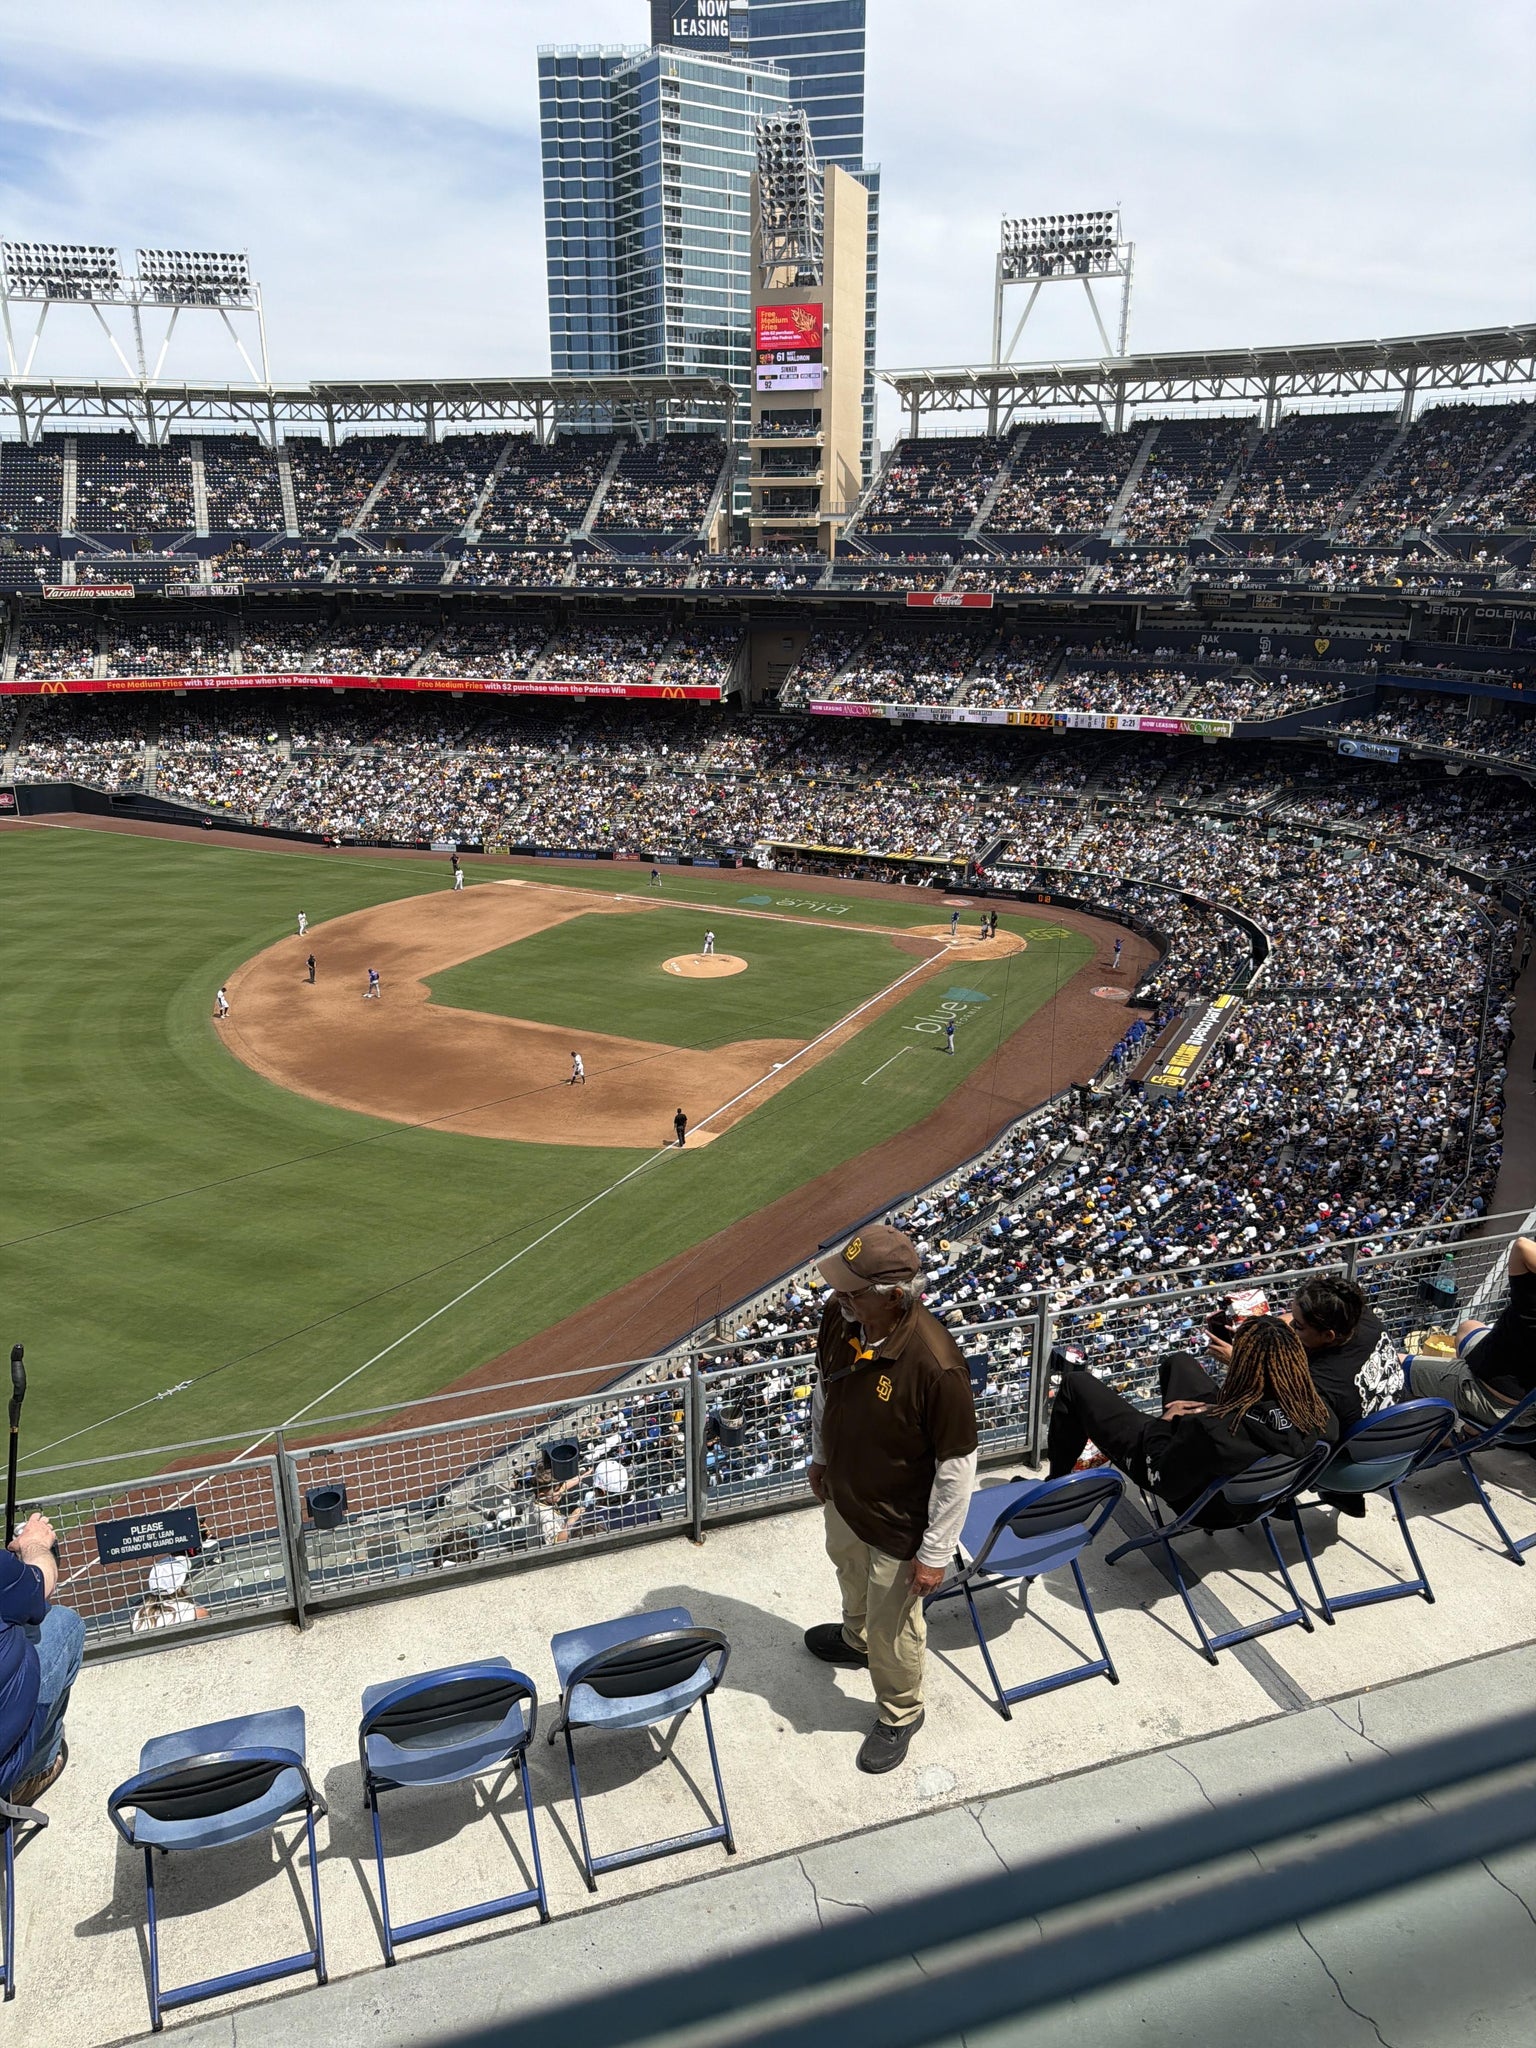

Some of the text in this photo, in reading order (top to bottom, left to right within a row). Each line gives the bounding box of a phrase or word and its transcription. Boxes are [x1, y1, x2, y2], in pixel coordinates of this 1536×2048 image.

[697, 0, 728, 17] NOW
[673, 19, 729, 37] LEASING
[776, 352, 785, 362] 61
[46, 587, 95, 598] Tarantino
[210, 586, 240, 595] $16,275
[1424, 606, 1469, 616] JERRY
[1200, 634, 1220, 644] RAK
[216, 678, 254, 687] purchase
[513, 684, 548, 692] purchase
[843, 705, 872, 715] ANCORA
[1110, 720, 1114, 728] 5
[1179, 723, 1211, 733] ANCORA
[901, 1002, 967, 1034] blue
[1189, 1020, 1214, 1041] petco
[1202, 1006, 1224, 1023] park
[130, 1522, 164, 1535] PLEASE
[158, 1530, 174, 1538] LEAN
[121, 1545, 141, 1554] STAND
[152, 1538, 174, 1548] GUARD
